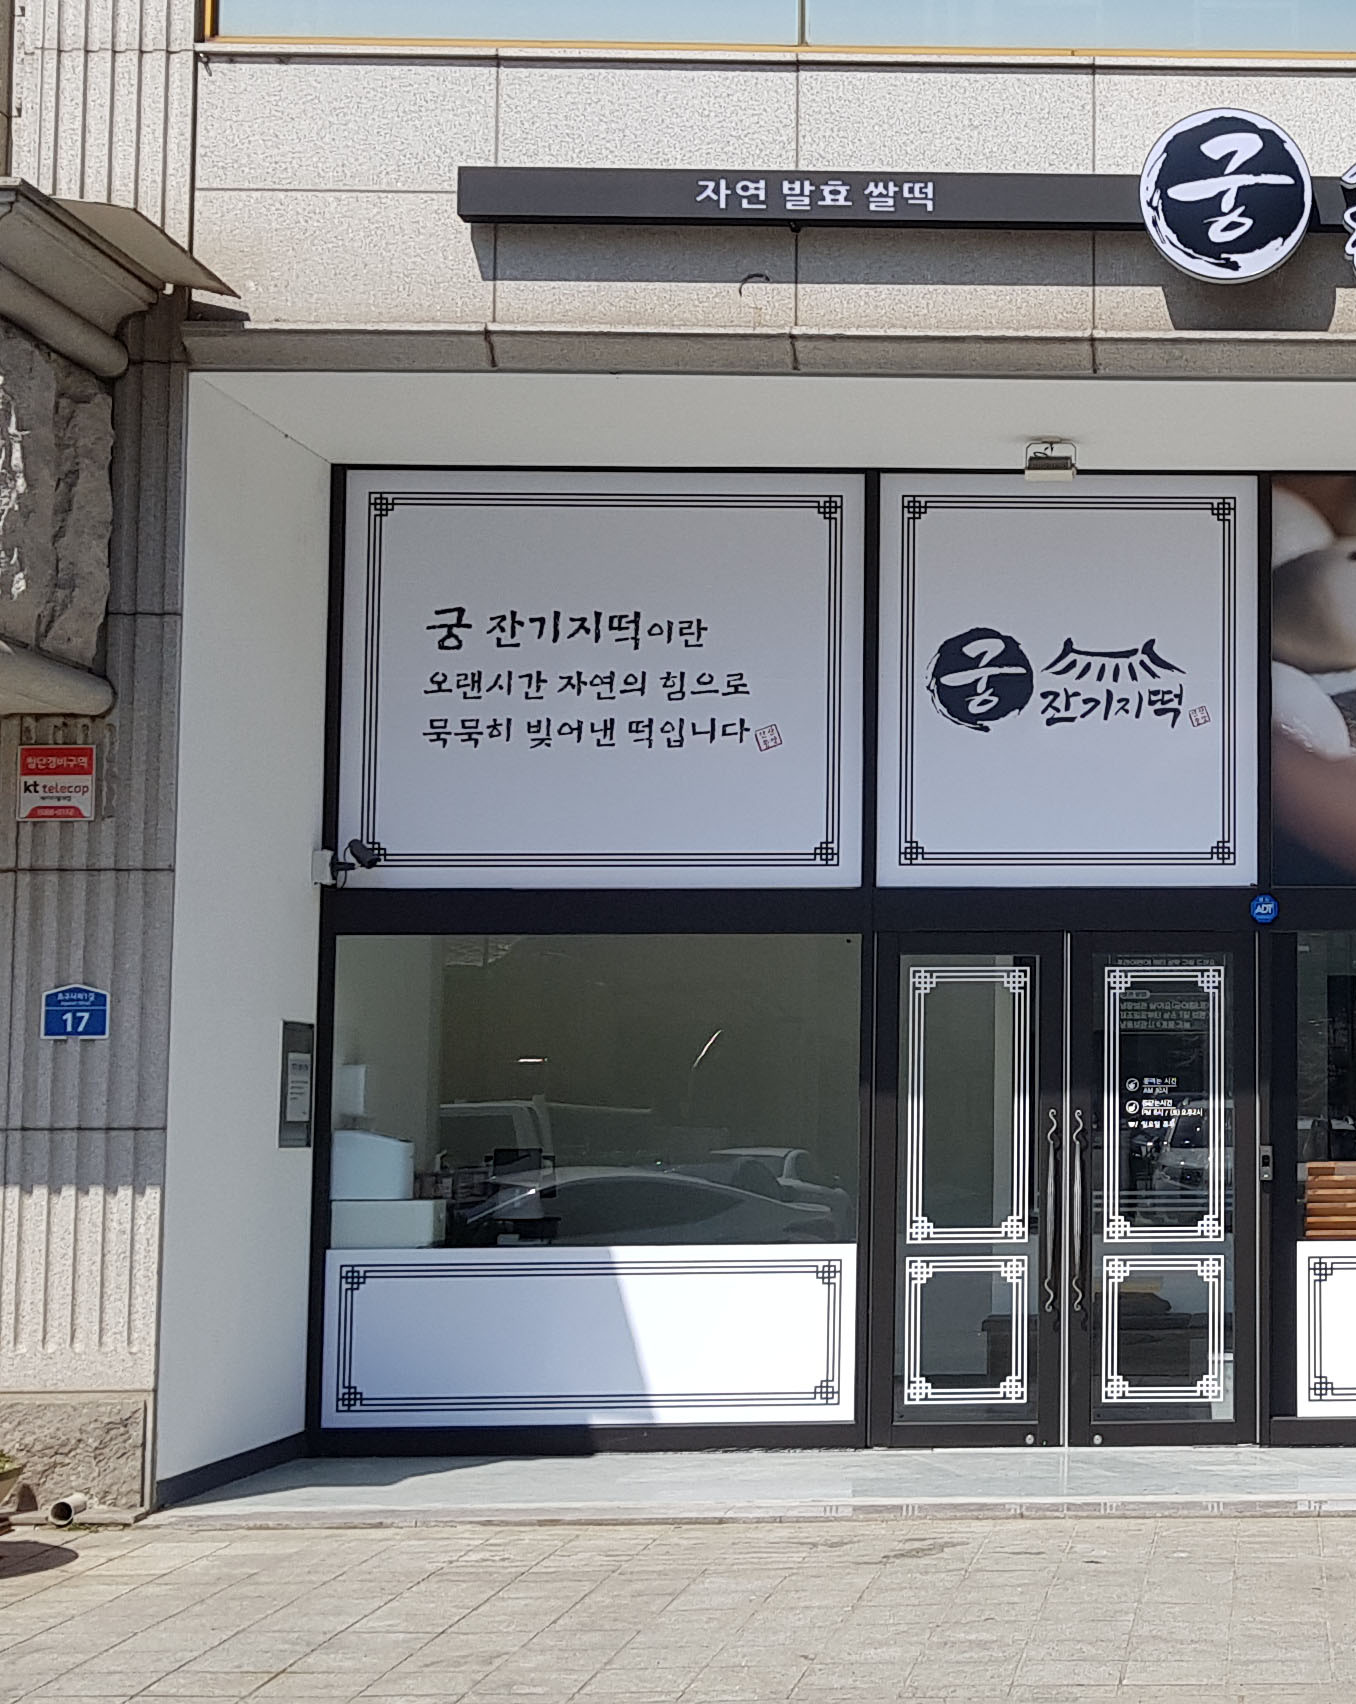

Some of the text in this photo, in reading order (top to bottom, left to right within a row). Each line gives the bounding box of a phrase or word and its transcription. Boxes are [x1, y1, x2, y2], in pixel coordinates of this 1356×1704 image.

[696, 179, 933, 211] 자연 발효 쌀떡
[426, 607, 708, 650] 궁 잔기지떡이란
[424, 670, 749, 701] 오랜시간 자연의 힘으로
[1040, 684, 1184, 728] 잔기지떡
[423, 718, 750, 748] 묵묵히 빚어낸 떡입니다
[23, 781, 89, 796] kt telecop
[1256, 904, 1273, 914] ADT
[62, 1012, 90, 1032] 17
